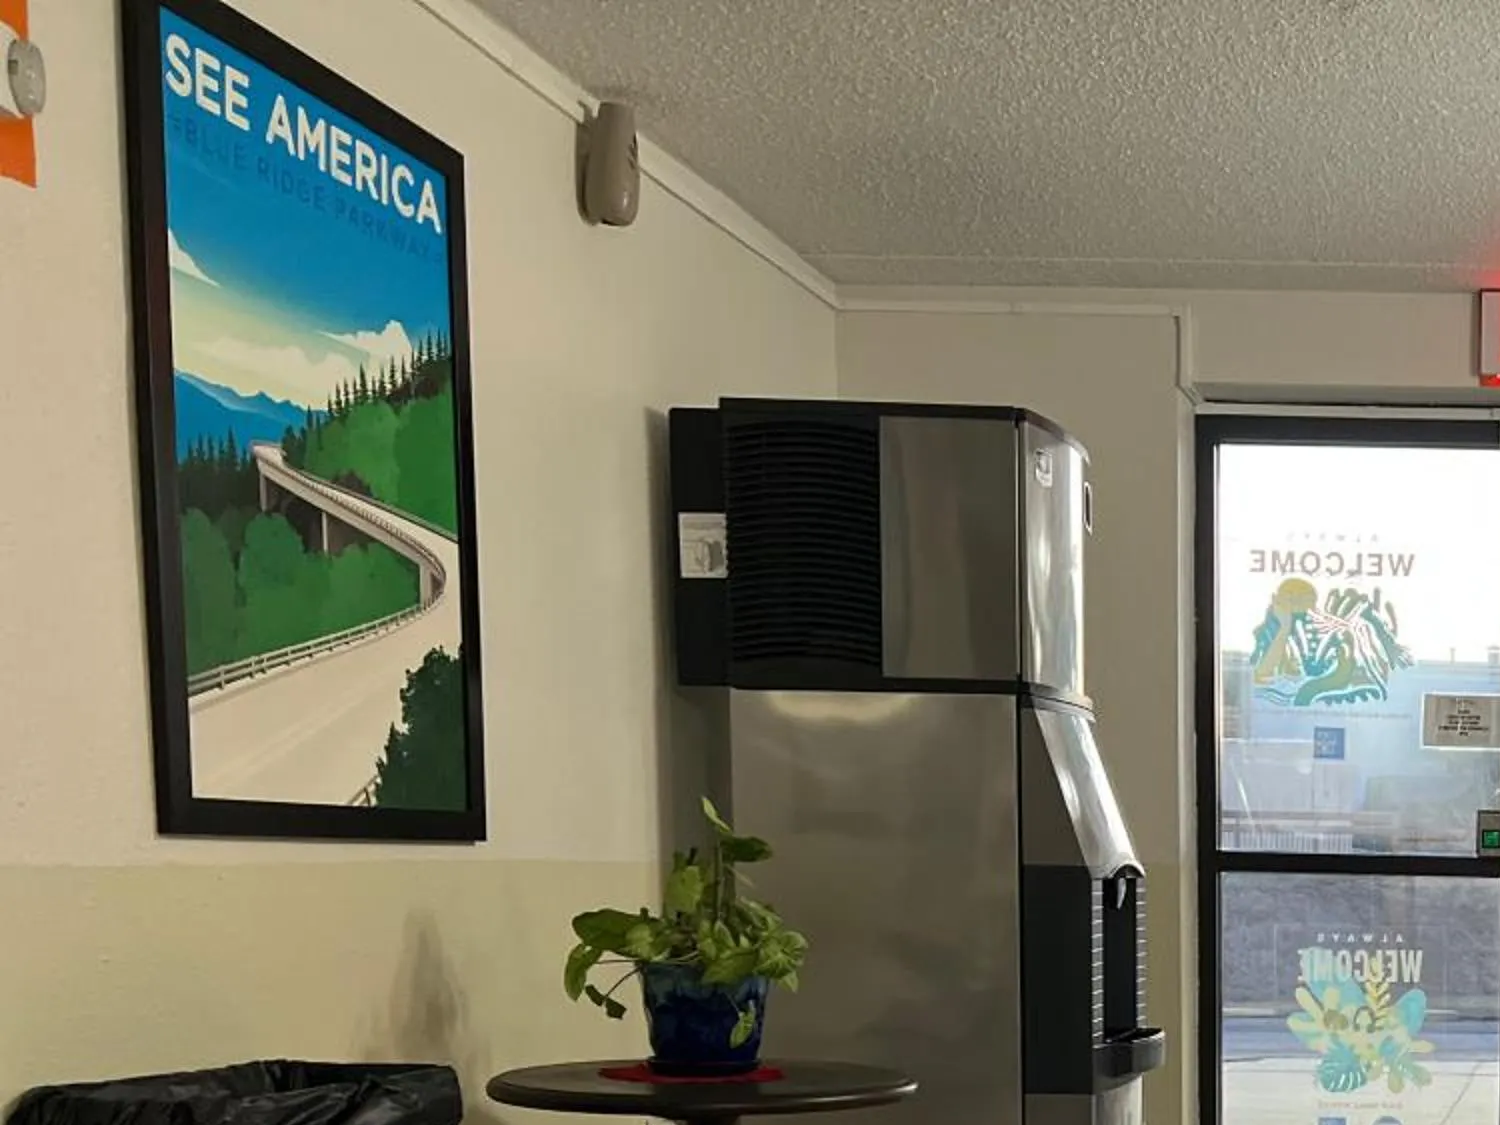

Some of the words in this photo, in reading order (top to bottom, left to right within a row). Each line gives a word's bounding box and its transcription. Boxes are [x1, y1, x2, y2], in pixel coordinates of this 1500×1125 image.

[165, 34, 250, 131] SEE
[266, 94, 442, 234] AMERICA
[185, 116, 249, 171] BLUE
[257, 155, 327, 211] RIDGE
[335, 196, 430, 256] PARKWAY
